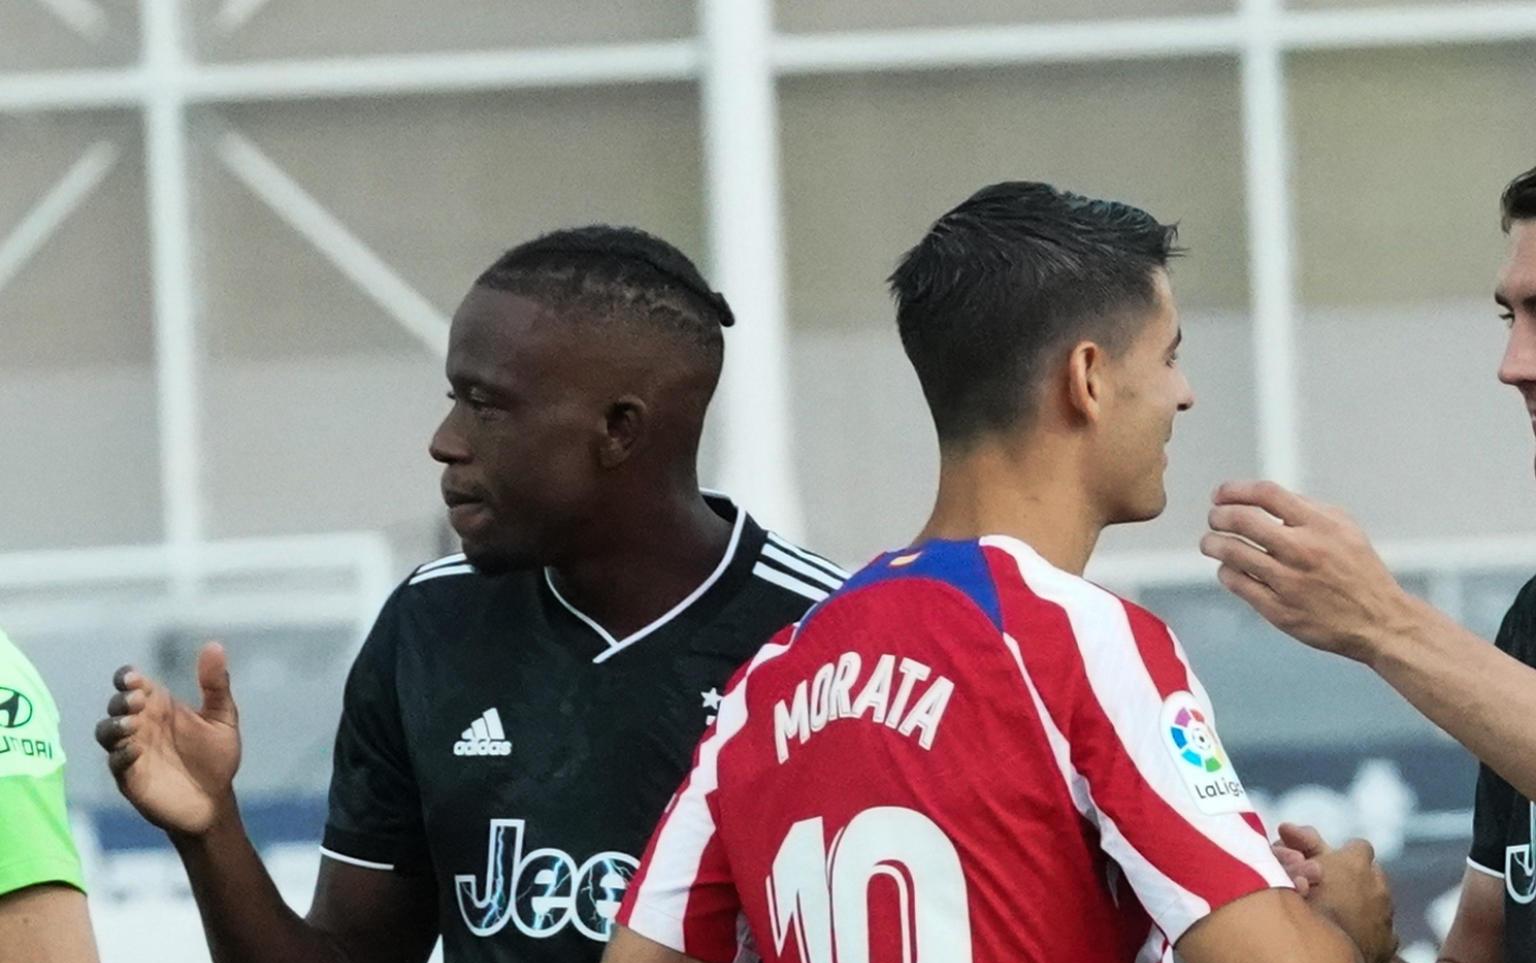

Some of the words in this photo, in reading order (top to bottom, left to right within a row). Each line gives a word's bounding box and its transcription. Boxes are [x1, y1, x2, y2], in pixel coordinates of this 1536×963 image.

[774, 651, 955, 765] MORATA
[1194, 777, 1244, 799] LaLig
[454, 818, 642, 942] Jee
